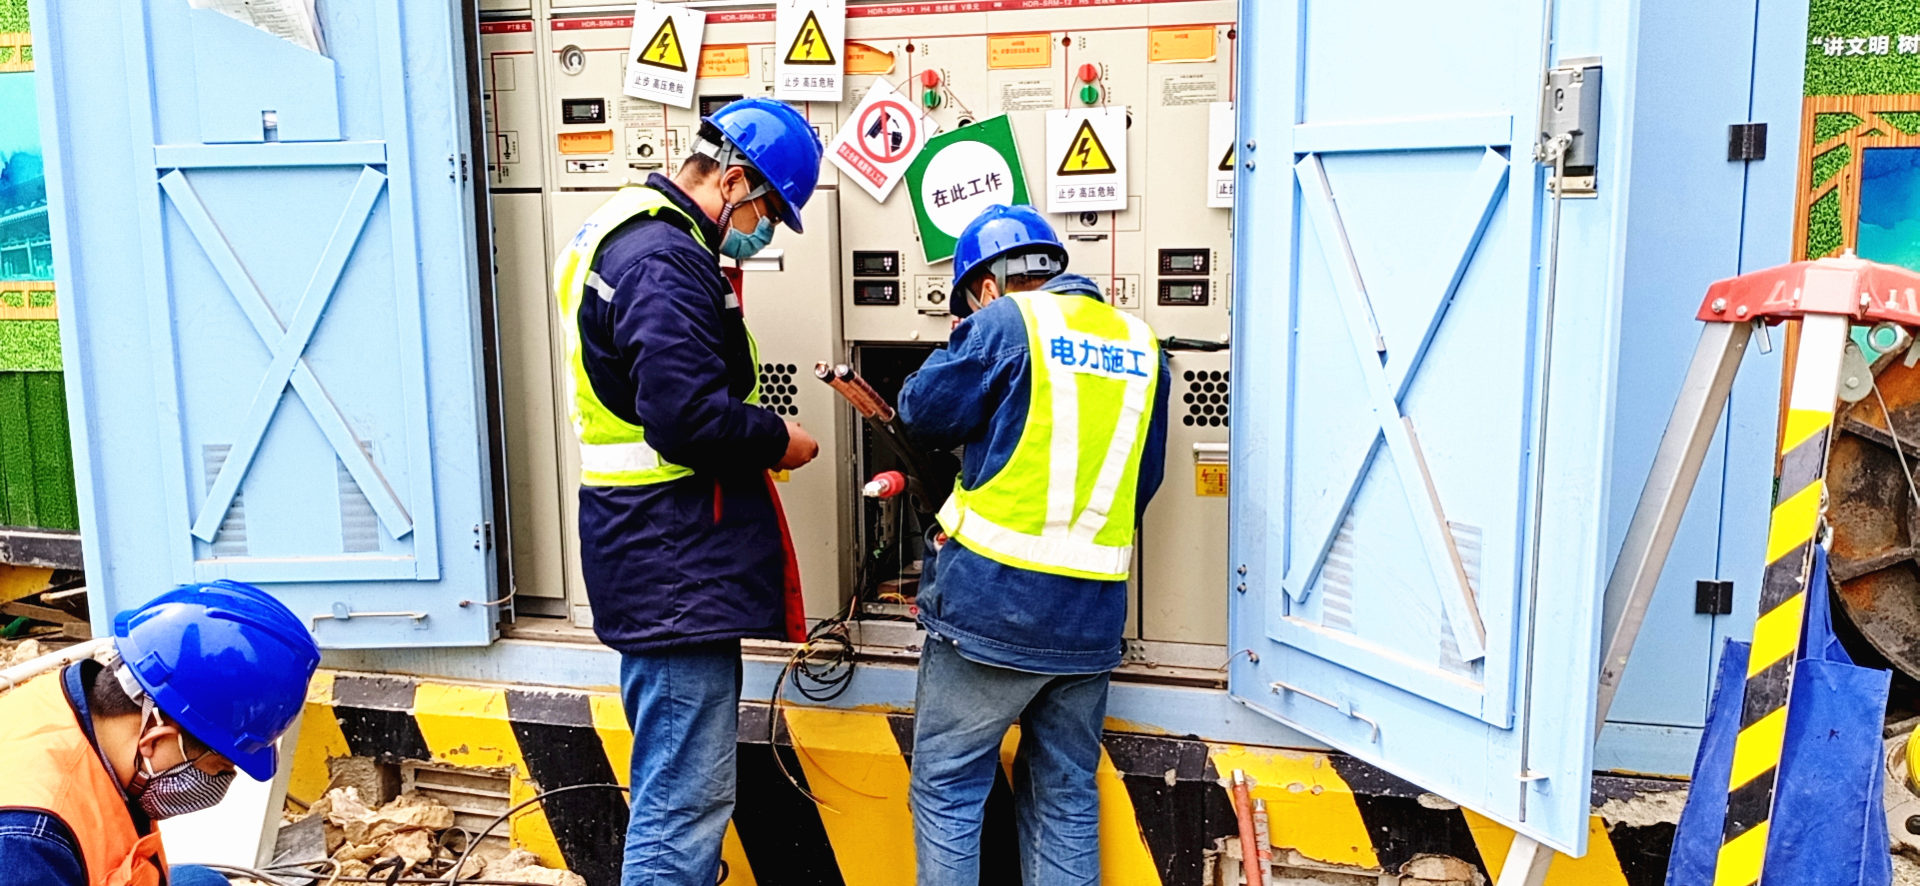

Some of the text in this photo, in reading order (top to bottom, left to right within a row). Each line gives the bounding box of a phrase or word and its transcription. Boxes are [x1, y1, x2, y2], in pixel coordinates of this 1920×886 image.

[1812, 34, 1920, 56] “讲文明 树
[634, 75, 684, 95] 止步 高压危险
[784, 76, 835, 88] 止步 高压危险
[931, 172, 1002, 208] 在此工作
[1058, 185, 1116, 200] 止步 高压危险
[1050, 335, 1149, 378] 电力施工
